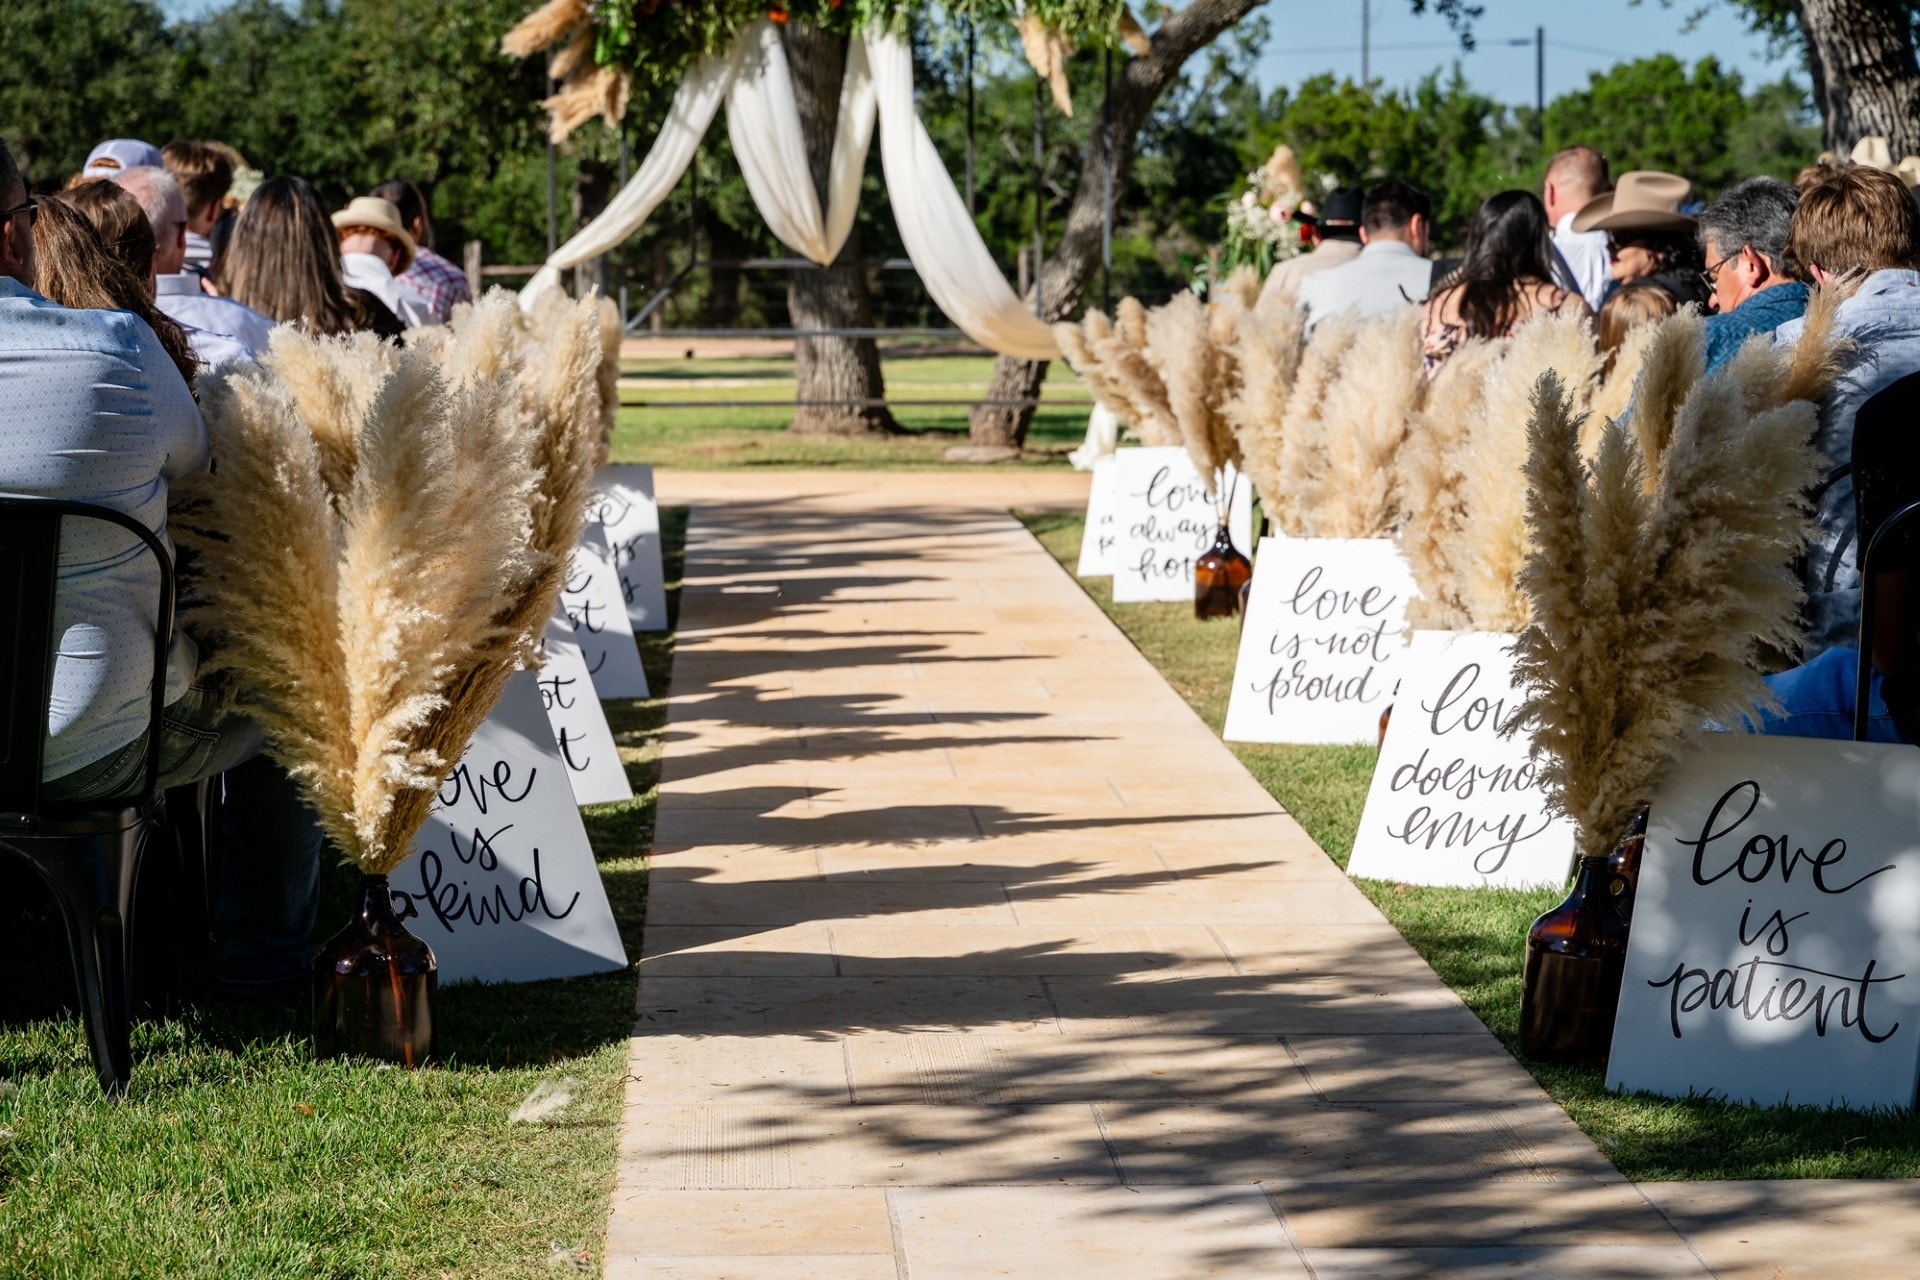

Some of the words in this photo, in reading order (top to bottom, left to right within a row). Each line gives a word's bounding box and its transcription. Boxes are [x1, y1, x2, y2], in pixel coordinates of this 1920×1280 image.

[1128, 515, 1217, 551] alway
[1127, 547, 1196, 582] hop
[566, 599, 606, 634] ot
[1280, 566, 1397, 620] love
[1270, 630, 1313, 659] is
[1315, 619, 1404, 662] not
[538, 675, 576, 710] ot
[1251, 659, 1382, 715] proud
[1421, 662, 1522, 736] lov
[437, 760, 537, 815] ove
[1391, 748, 1477, 800] does
[1478, 757, 1547, 793] no
[450, 823, 514, 871] is
[1386, 805, 1552, 874] envy
[1675, 780, 1897, 894] love
[411, 848, 580, 933] kind
[1738, 899, 1810, 956] is
[1647, 955, 1906, 1043] patient
